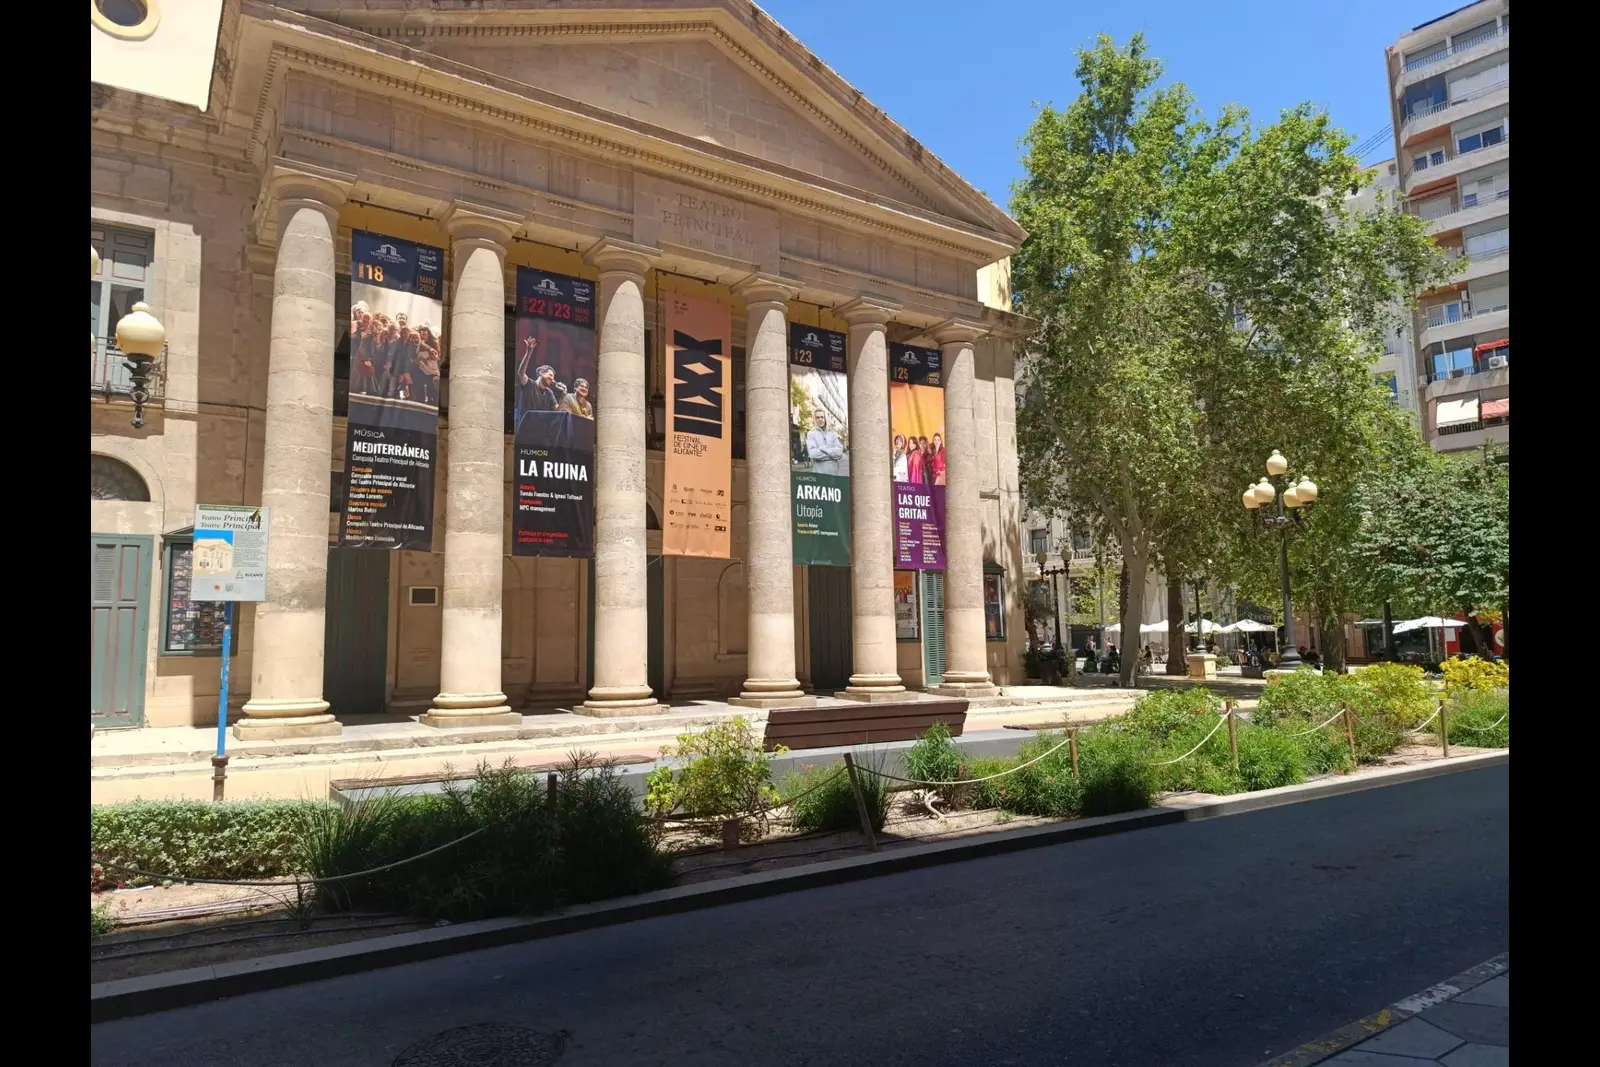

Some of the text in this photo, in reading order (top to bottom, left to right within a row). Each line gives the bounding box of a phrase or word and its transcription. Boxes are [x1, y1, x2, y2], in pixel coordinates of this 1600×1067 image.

[675, 193, 741, 219] TEATRO
[660, 209, 754, 245] PRINCIPAL
[366, 263, 384, 282] 18
[420, 275, 437, 286] MAYO
[528, 297, 546, 314] 22
[554, 303, 571, 319] 23
[799, 349, 812, 363] 23
[897, 367, 908, 379] 25
[353, 429, 385, 438] MÚSICA
[673, 434, 701, 444] FESTIVAL
[352, 440, 430, 460] MEDITERRÁNEAS
[673, 440, 708, 452] DE CINE DE
[673, 447, 703, 457] ALICANTE
[374, 456, 389, 464] Teatro
[389, 457, 408, 466] Principal
[520, 459, 588, 481] LA RUINA
[796, 484, 842, 503] ARKANO
[898, 493, 931, 507] LAS QUE
[796, 504, 823, 519] Utopía
[898, 507, 927, 520] GRITAN
